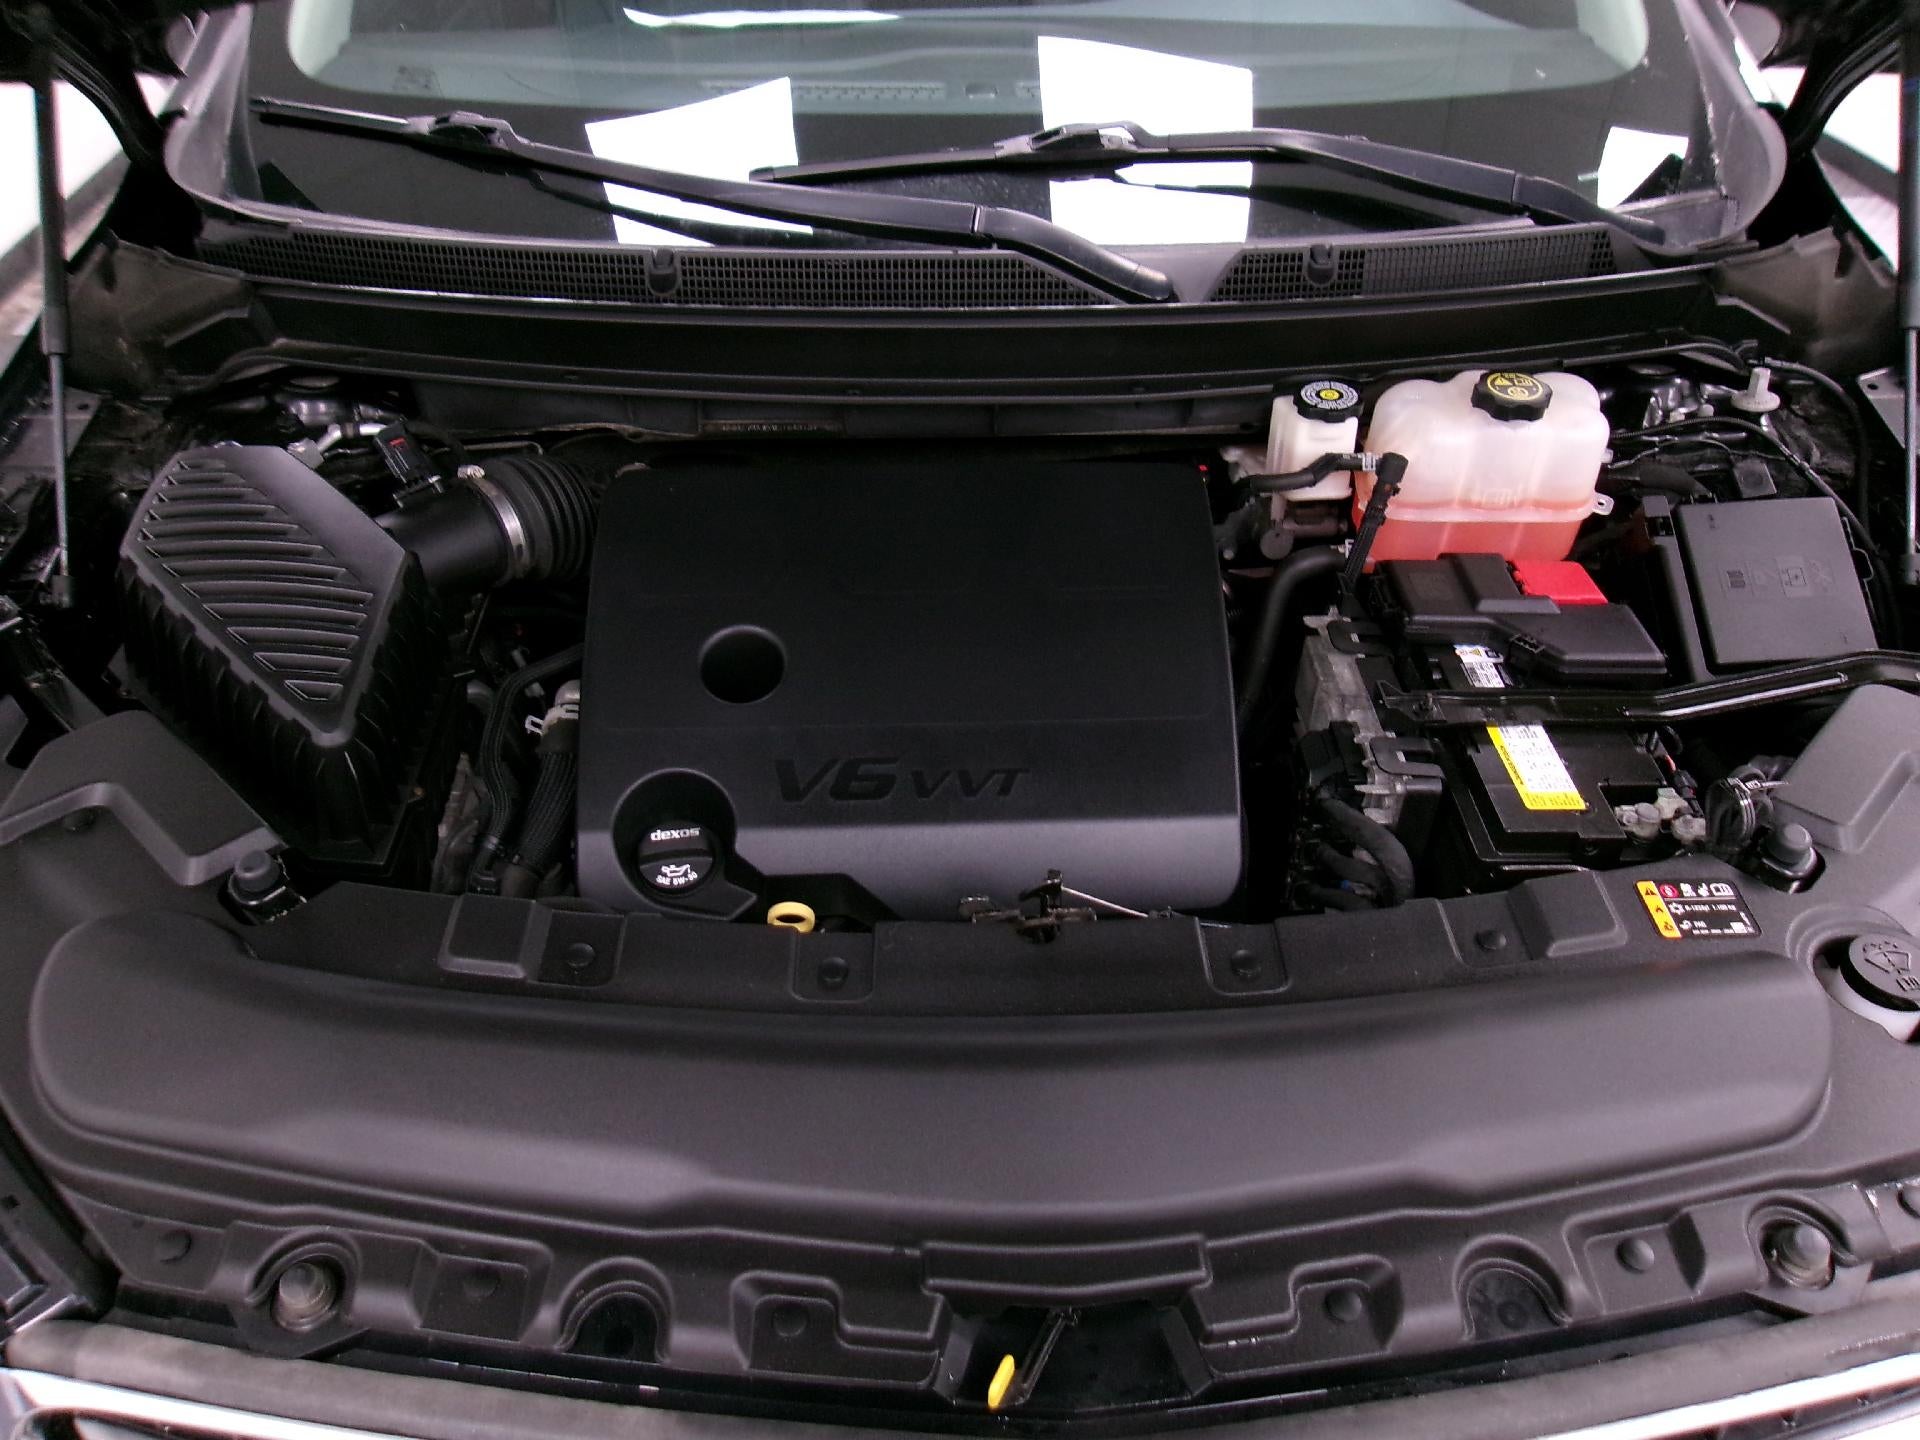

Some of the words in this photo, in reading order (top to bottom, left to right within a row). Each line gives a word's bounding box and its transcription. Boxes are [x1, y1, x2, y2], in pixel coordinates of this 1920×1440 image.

[775, 758, 899, 802] V6
[911, 767, 1030, 798] VVT
[650, 827, 700, 841] dexos
